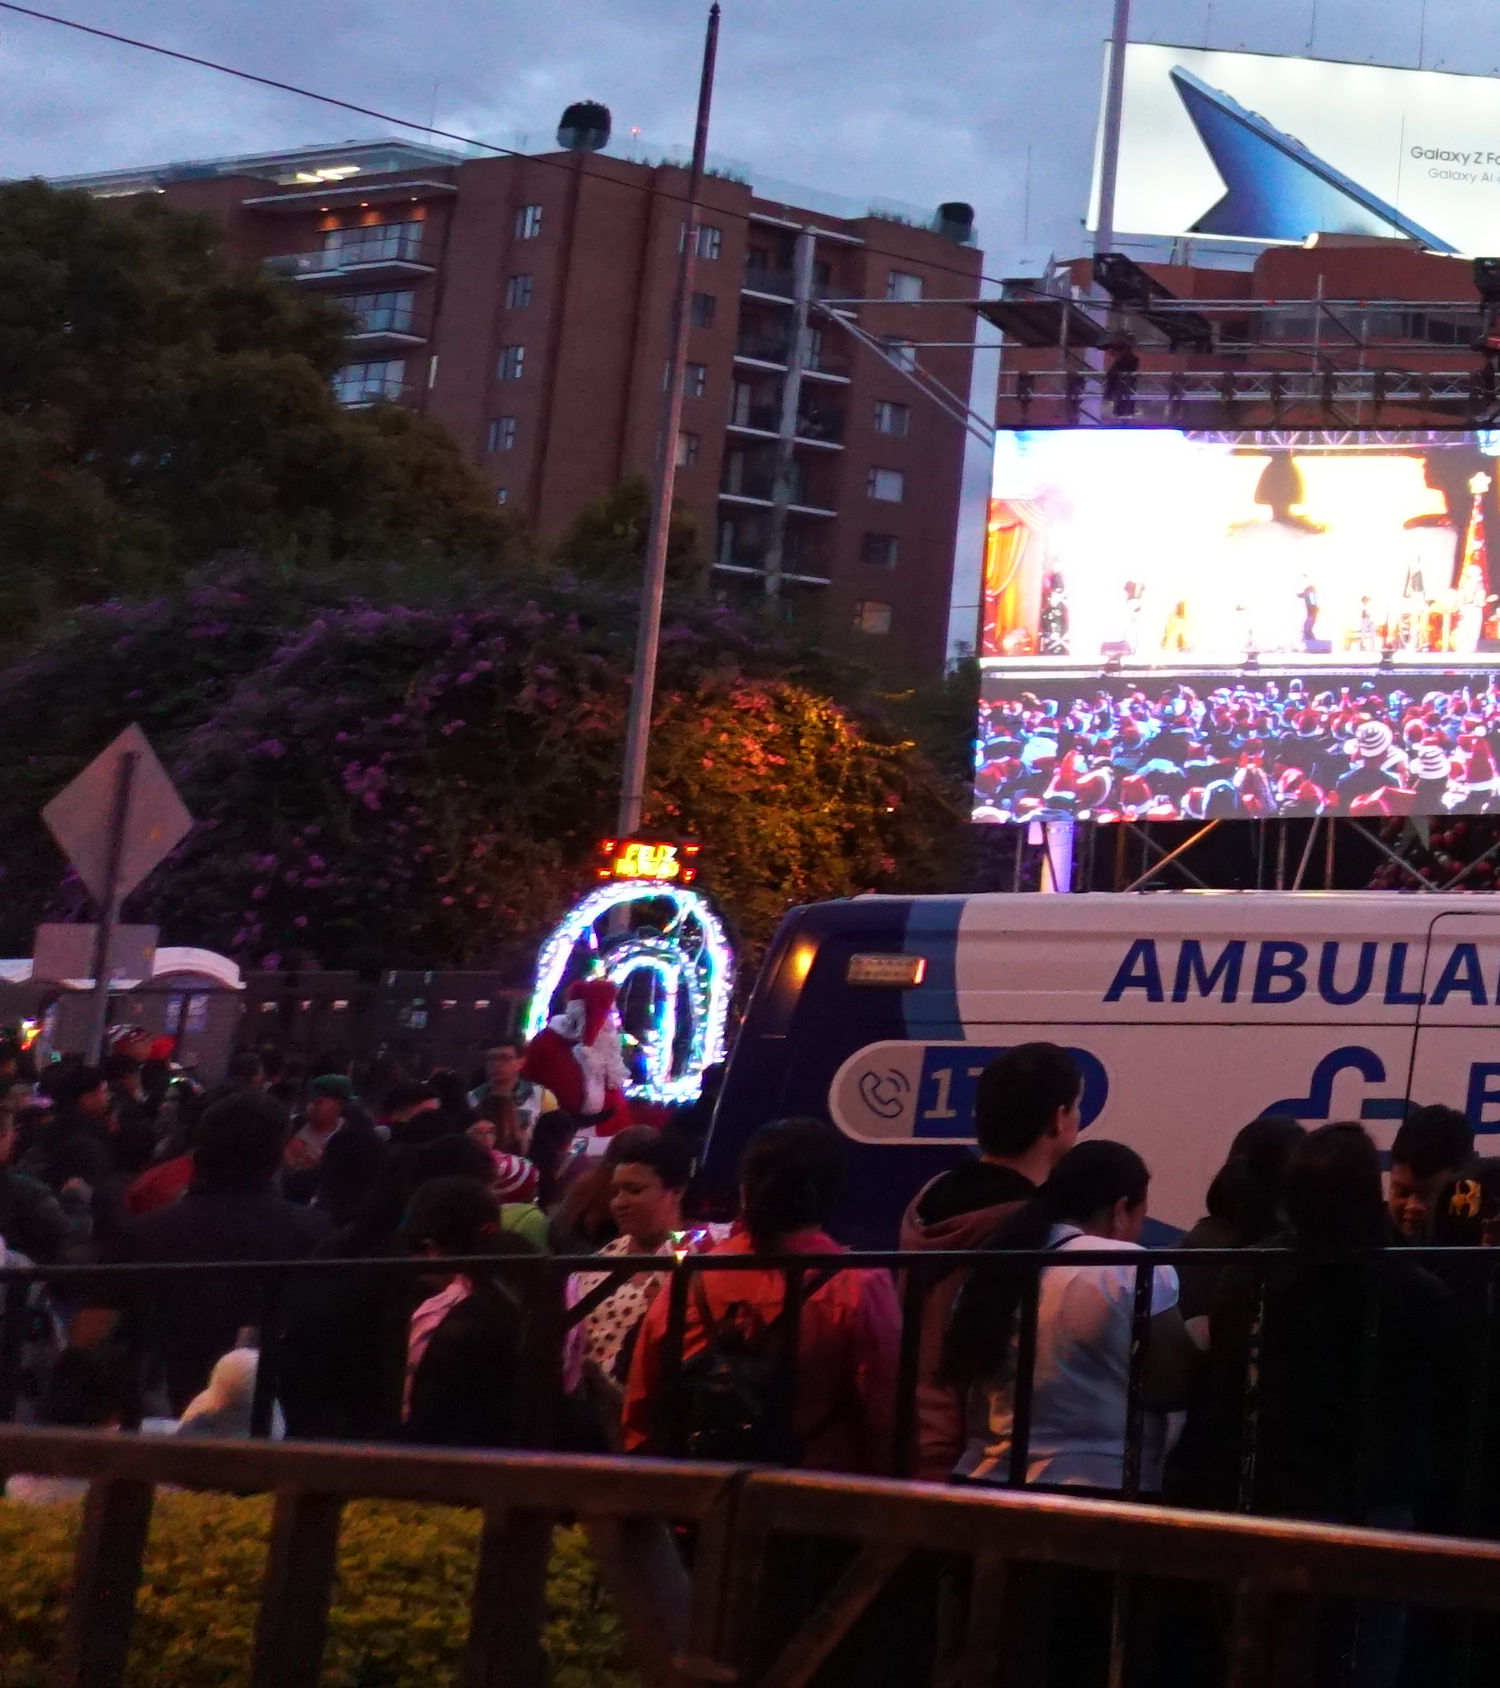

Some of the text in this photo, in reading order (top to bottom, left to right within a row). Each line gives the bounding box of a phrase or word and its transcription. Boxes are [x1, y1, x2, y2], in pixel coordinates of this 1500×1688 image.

[1410, 145, 1472, 166] Galaxy
[1473, 151, 1483, 164] Z
[1428, 167, 1477, 184] Galaxy
